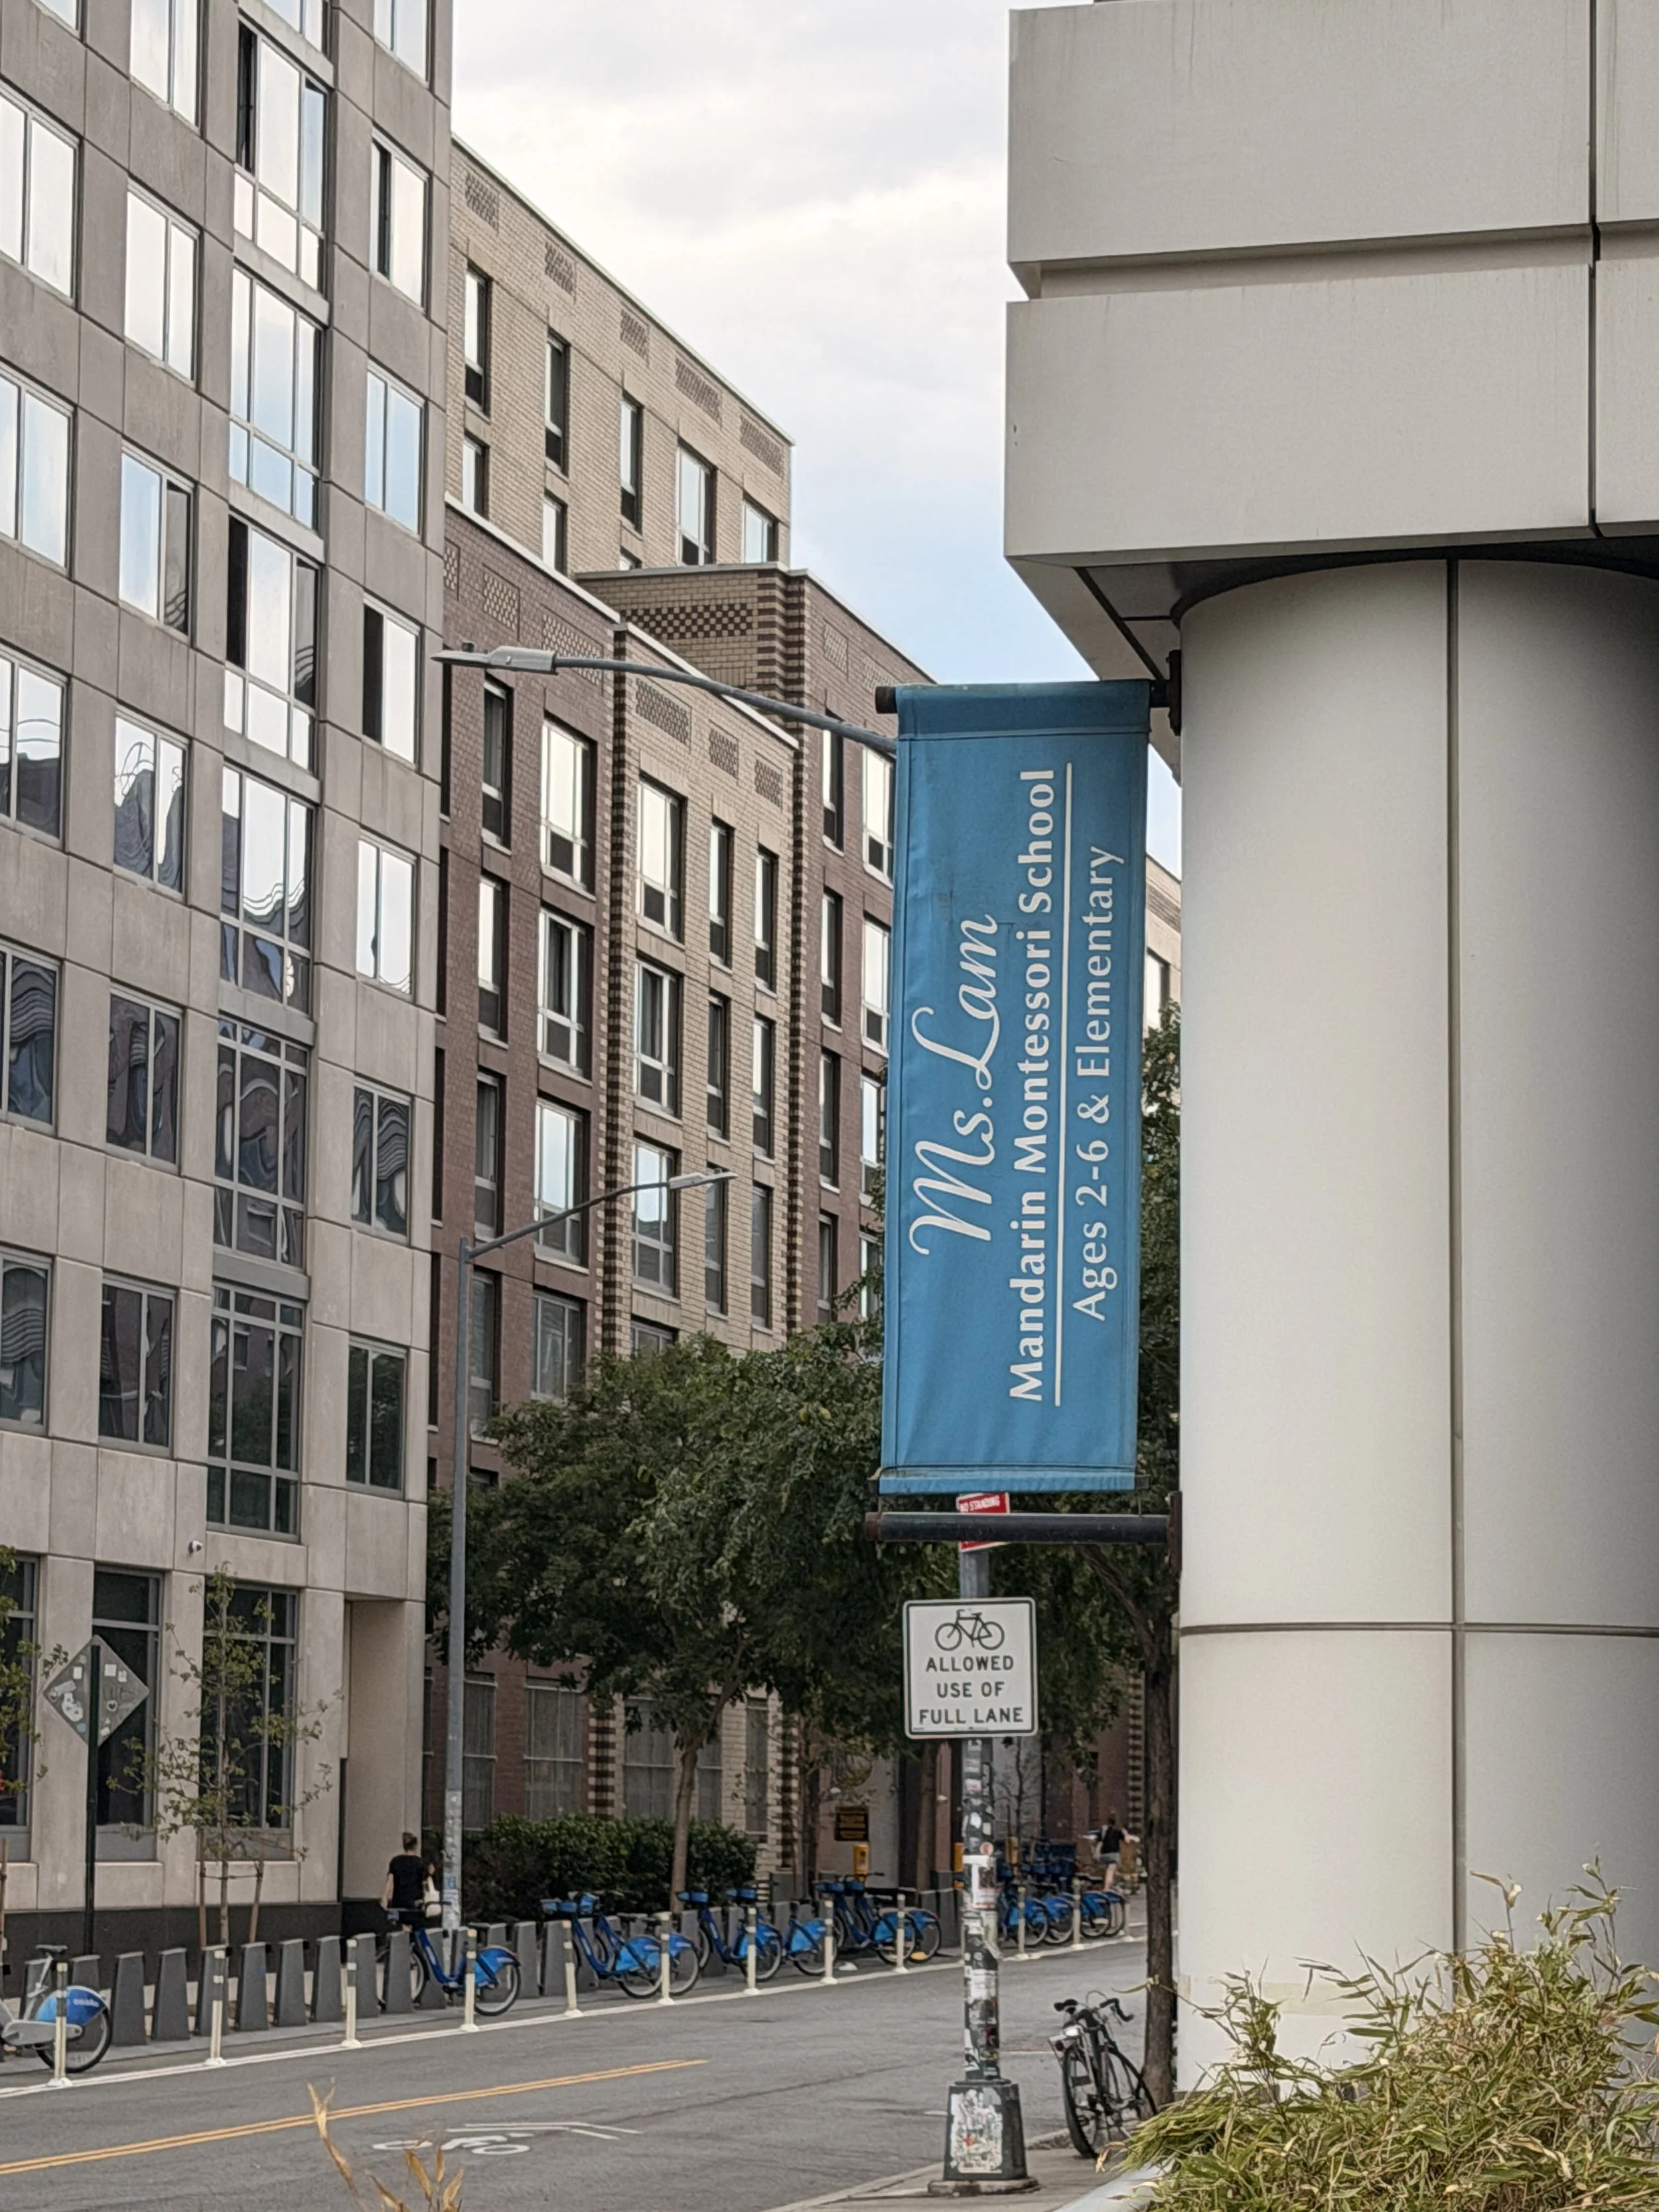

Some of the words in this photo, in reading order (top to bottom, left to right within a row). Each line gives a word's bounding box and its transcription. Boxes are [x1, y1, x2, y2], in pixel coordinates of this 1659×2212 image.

[1018, 770, 1054, 913] School
[1075, 846, 1124, 1076] Elementary
[1013, 930, 1050, 1173] Montessori
[1077, 1095, 1110, 1124] &
[1075, 1140, 1108, 1206] 2-6
[1009, 1191, 1046, 1401] Mandarin
[1072, 1222, 1118, 1321] Ages
[925, 1655, 1015, 1672] ALLOWED
[936, 1681, 973, 1698] USE
[980, 1680, 1005, 1698] OF
[918, 1708, 966, 1725] FULL
[974, 1706, 1023, 1724] LANE
